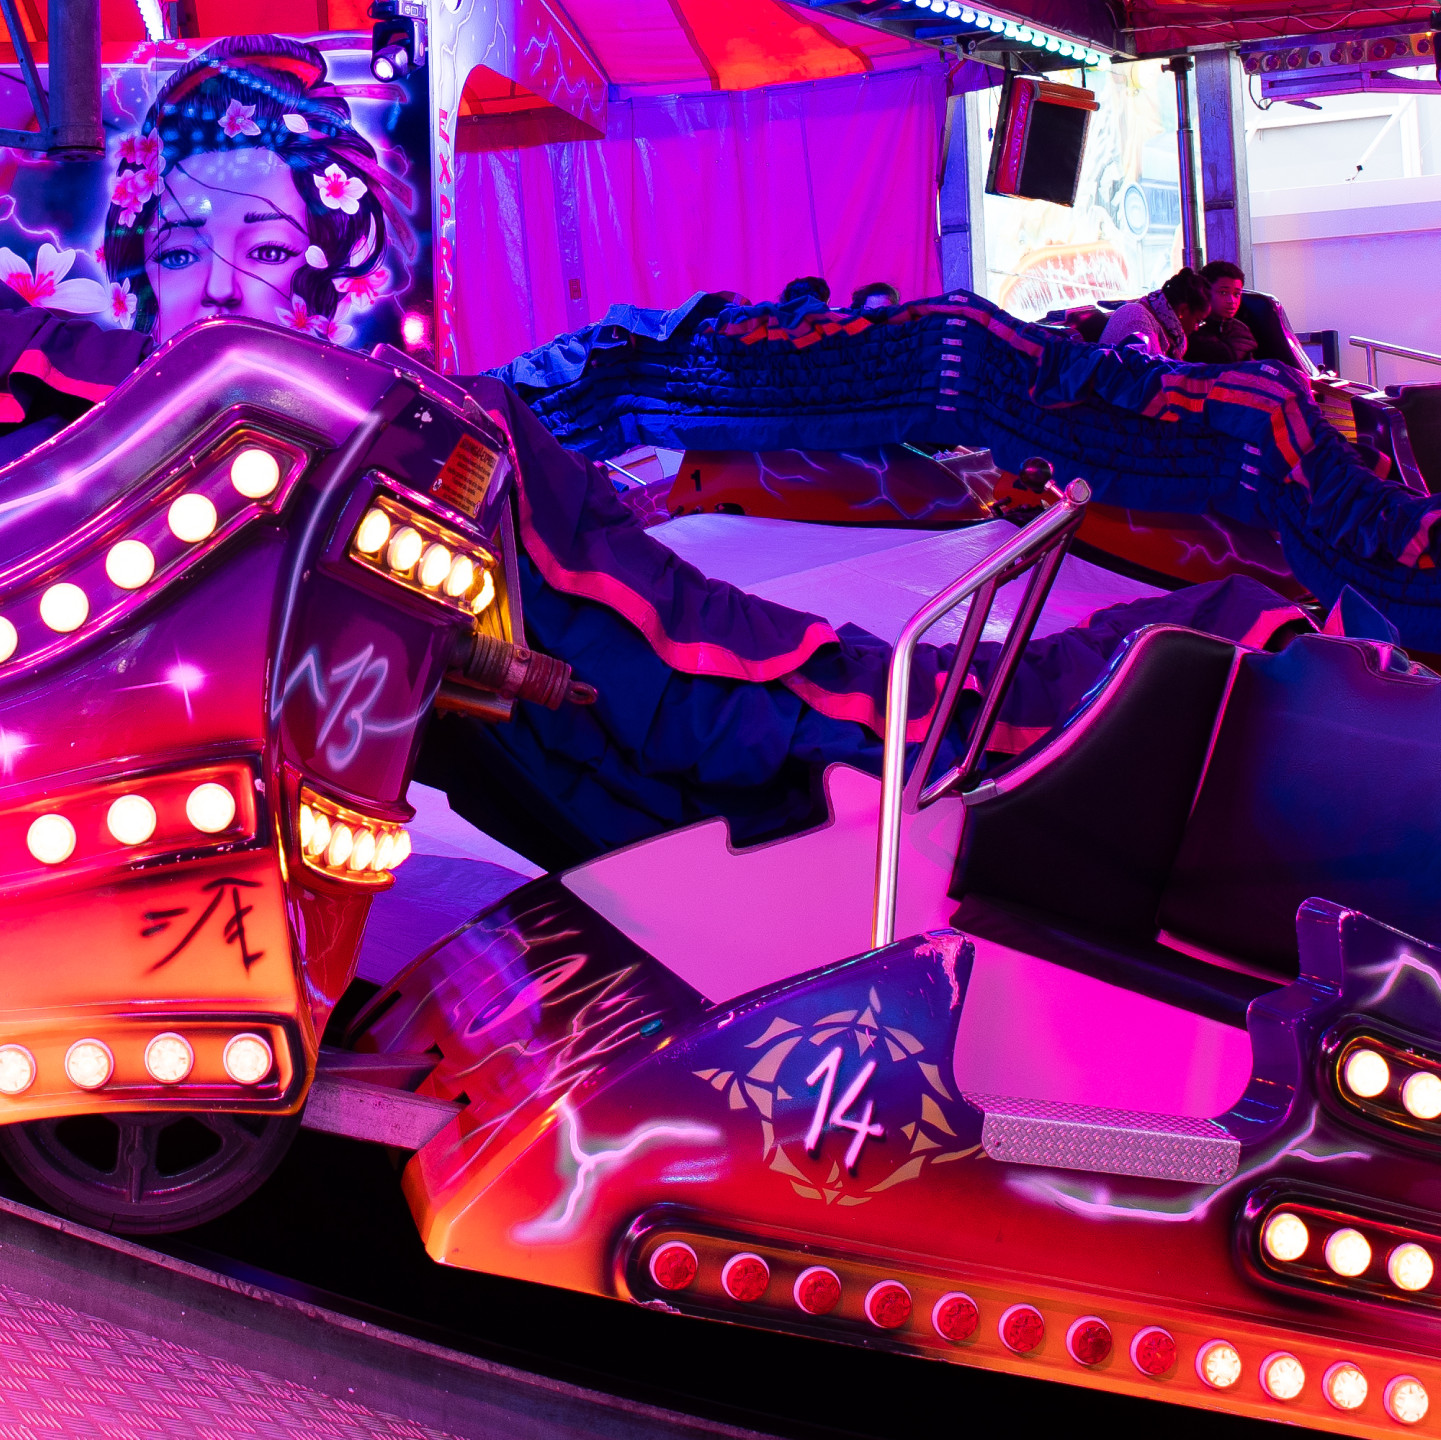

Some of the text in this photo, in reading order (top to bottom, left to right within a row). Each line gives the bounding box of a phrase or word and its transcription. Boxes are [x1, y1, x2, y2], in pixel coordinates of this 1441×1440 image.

[438, 107, 454, 376] EXPRES
[315, 643, 389, 772] 13
[805, 1046, 885, 1173] 14
